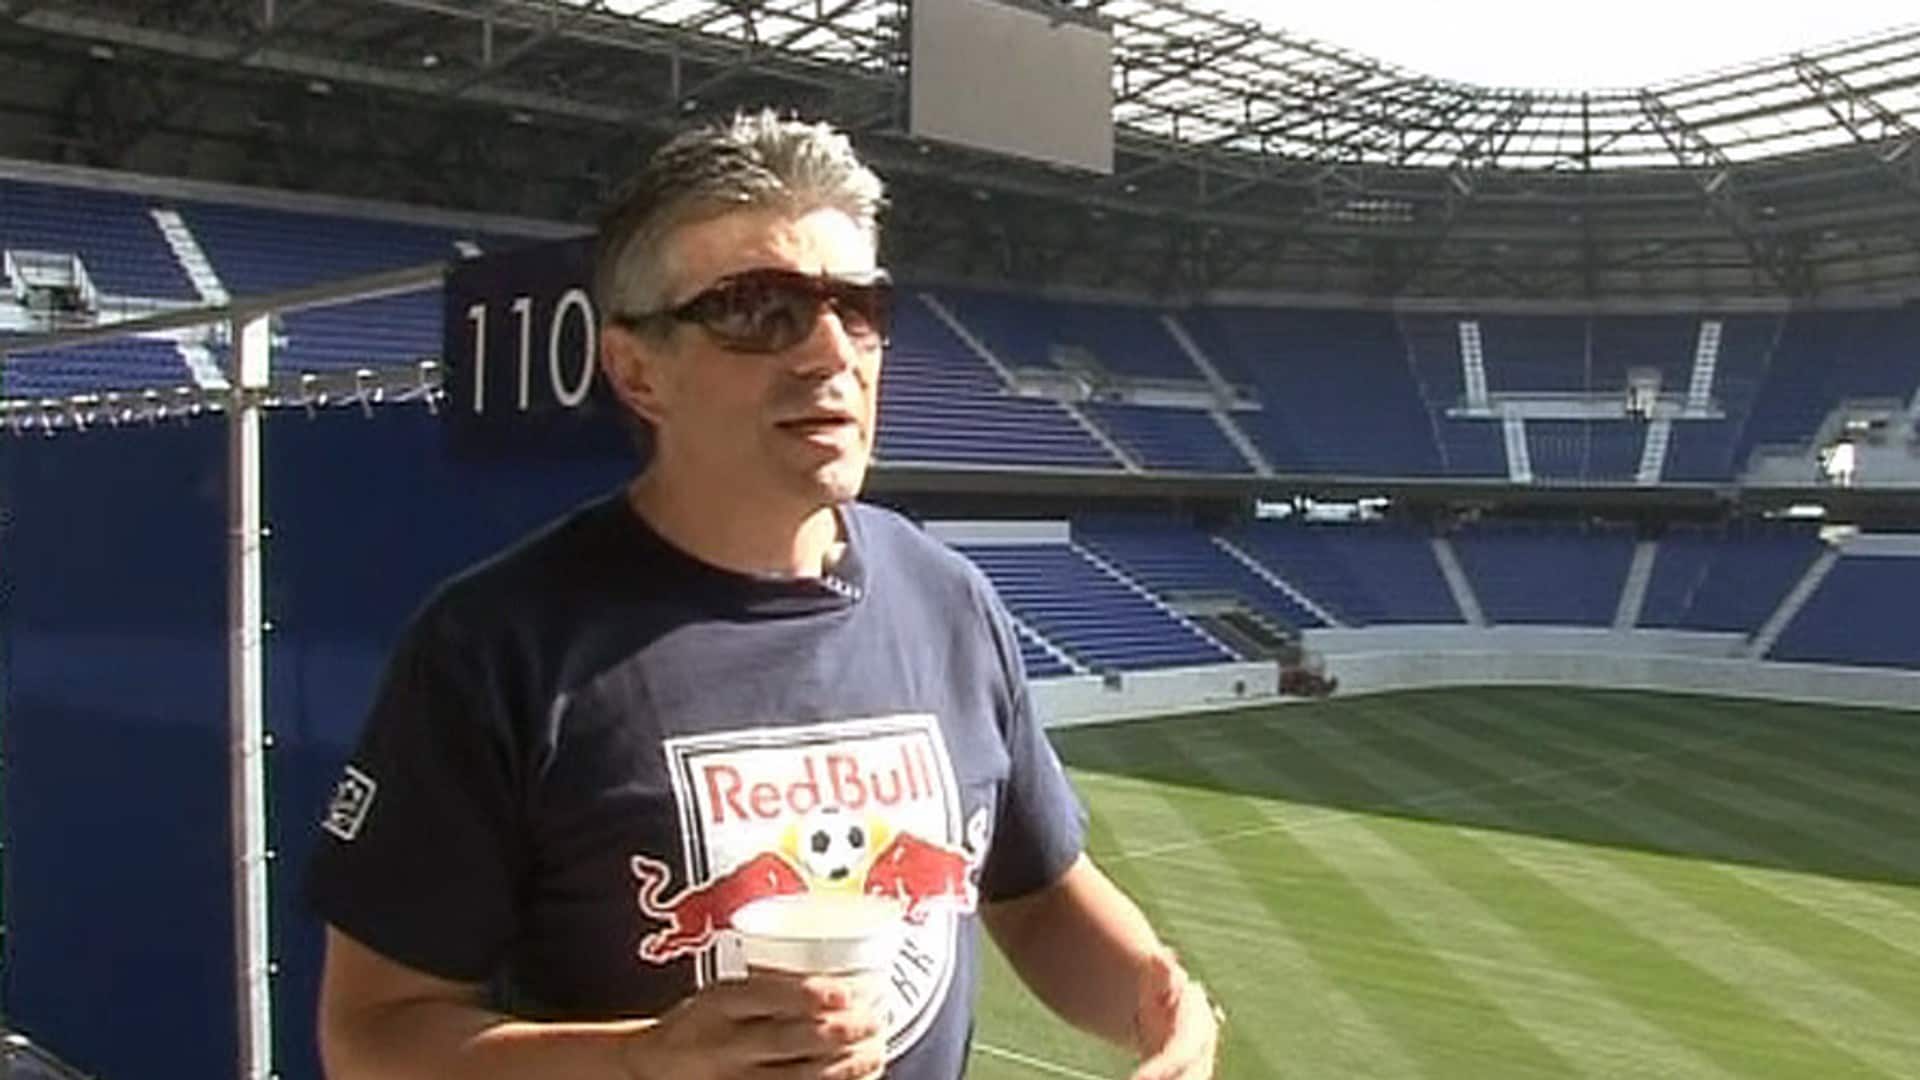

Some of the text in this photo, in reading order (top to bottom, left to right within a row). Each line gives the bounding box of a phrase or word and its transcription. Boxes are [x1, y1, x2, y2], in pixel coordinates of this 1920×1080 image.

[467, 288, 596, 413] 110
[702, 744, 934, 825] Red Bull
